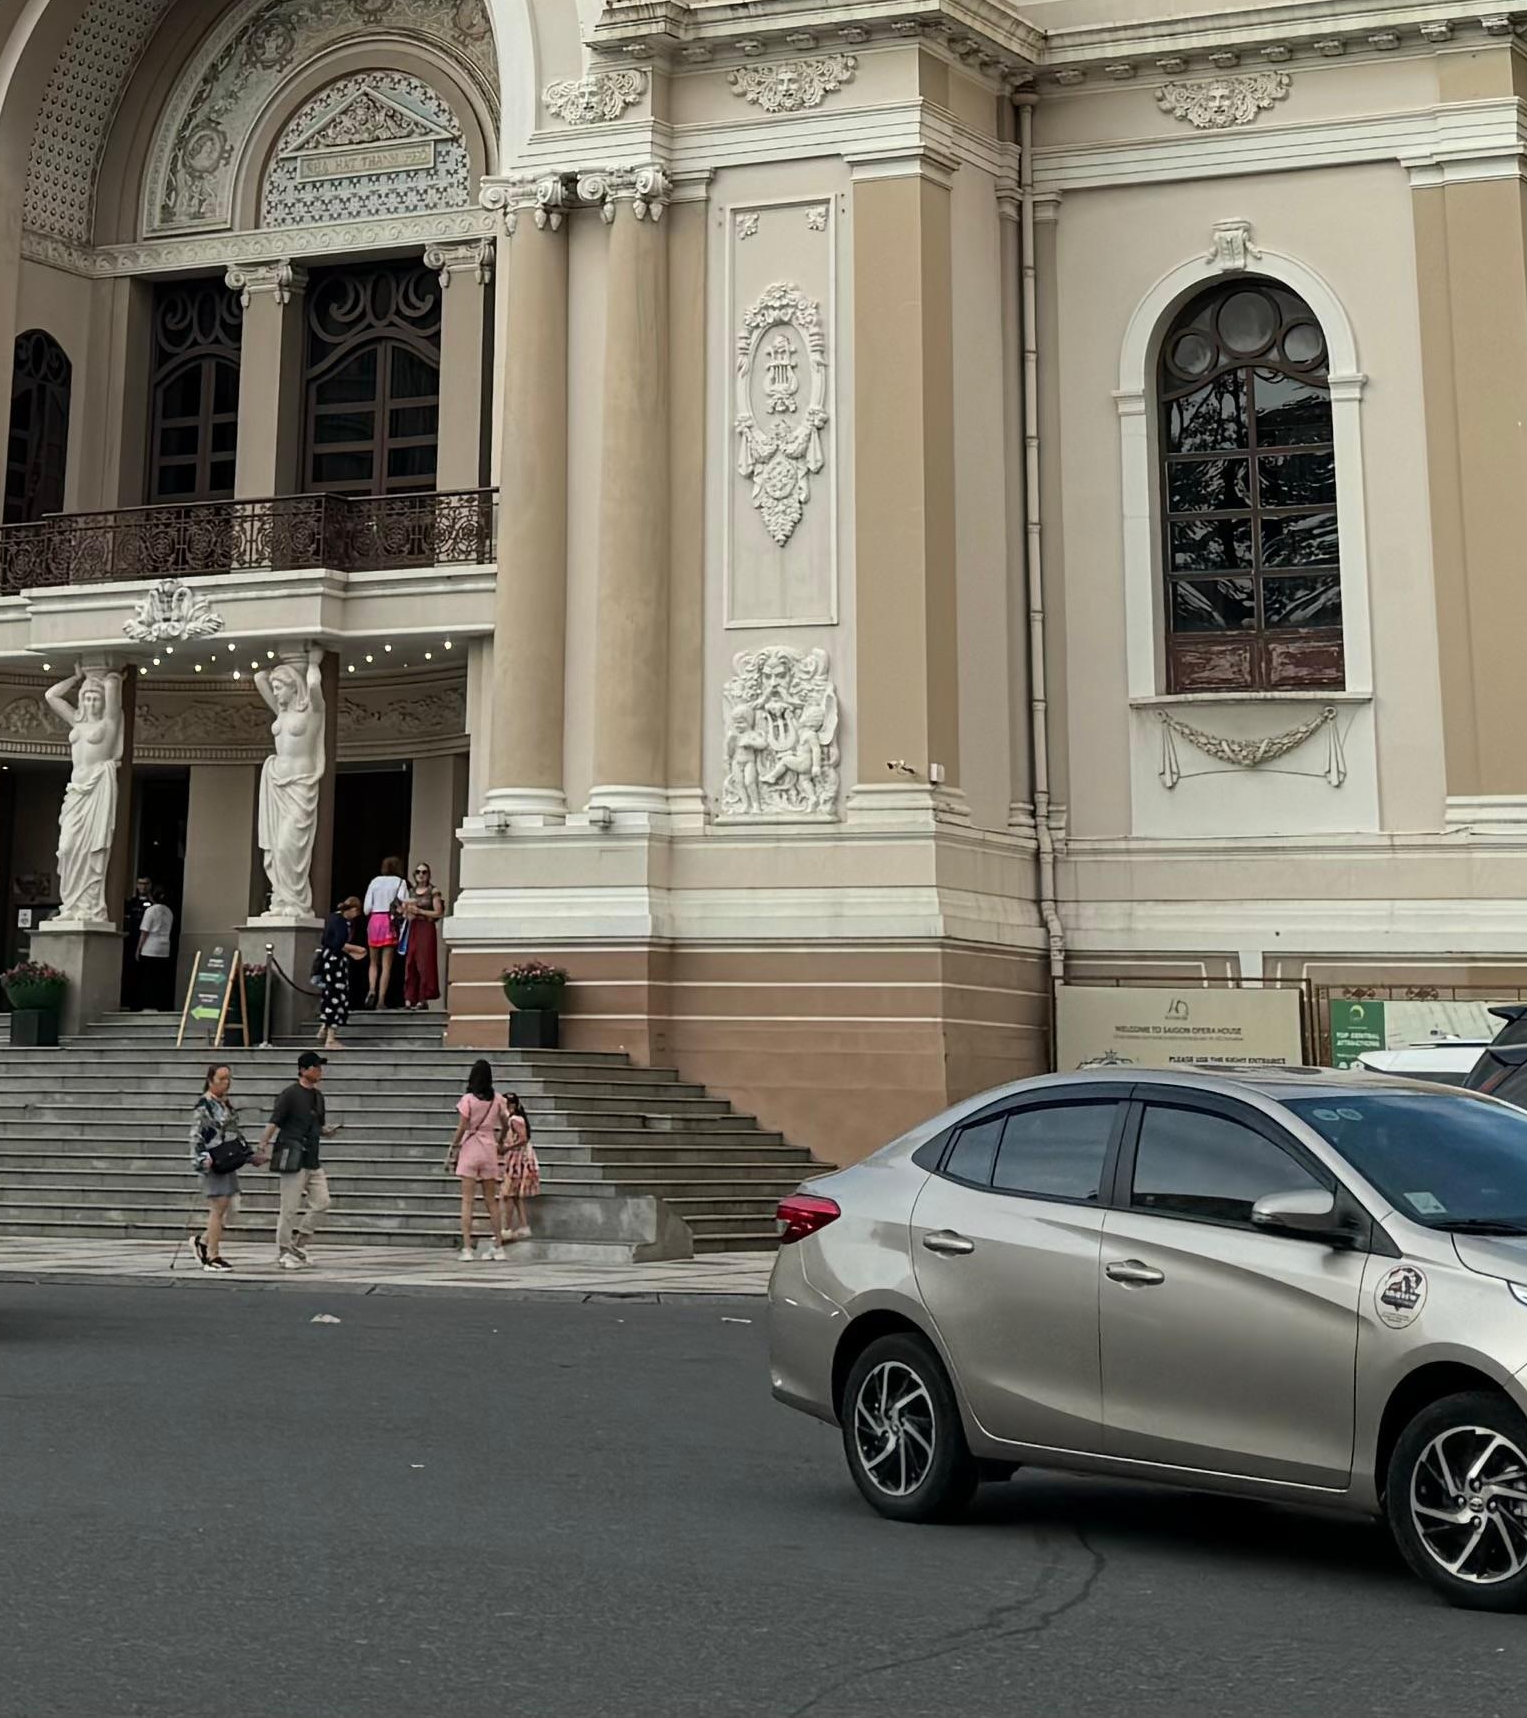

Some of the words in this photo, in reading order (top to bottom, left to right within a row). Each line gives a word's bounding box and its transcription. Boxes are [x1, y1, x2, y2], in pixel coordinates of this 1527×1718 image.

[1152, 1026, 1162, 1034] TO
[1163, 1026, 1191, 1034] SAIGON
[1191, 1027, 1216, 1035] OPERA
